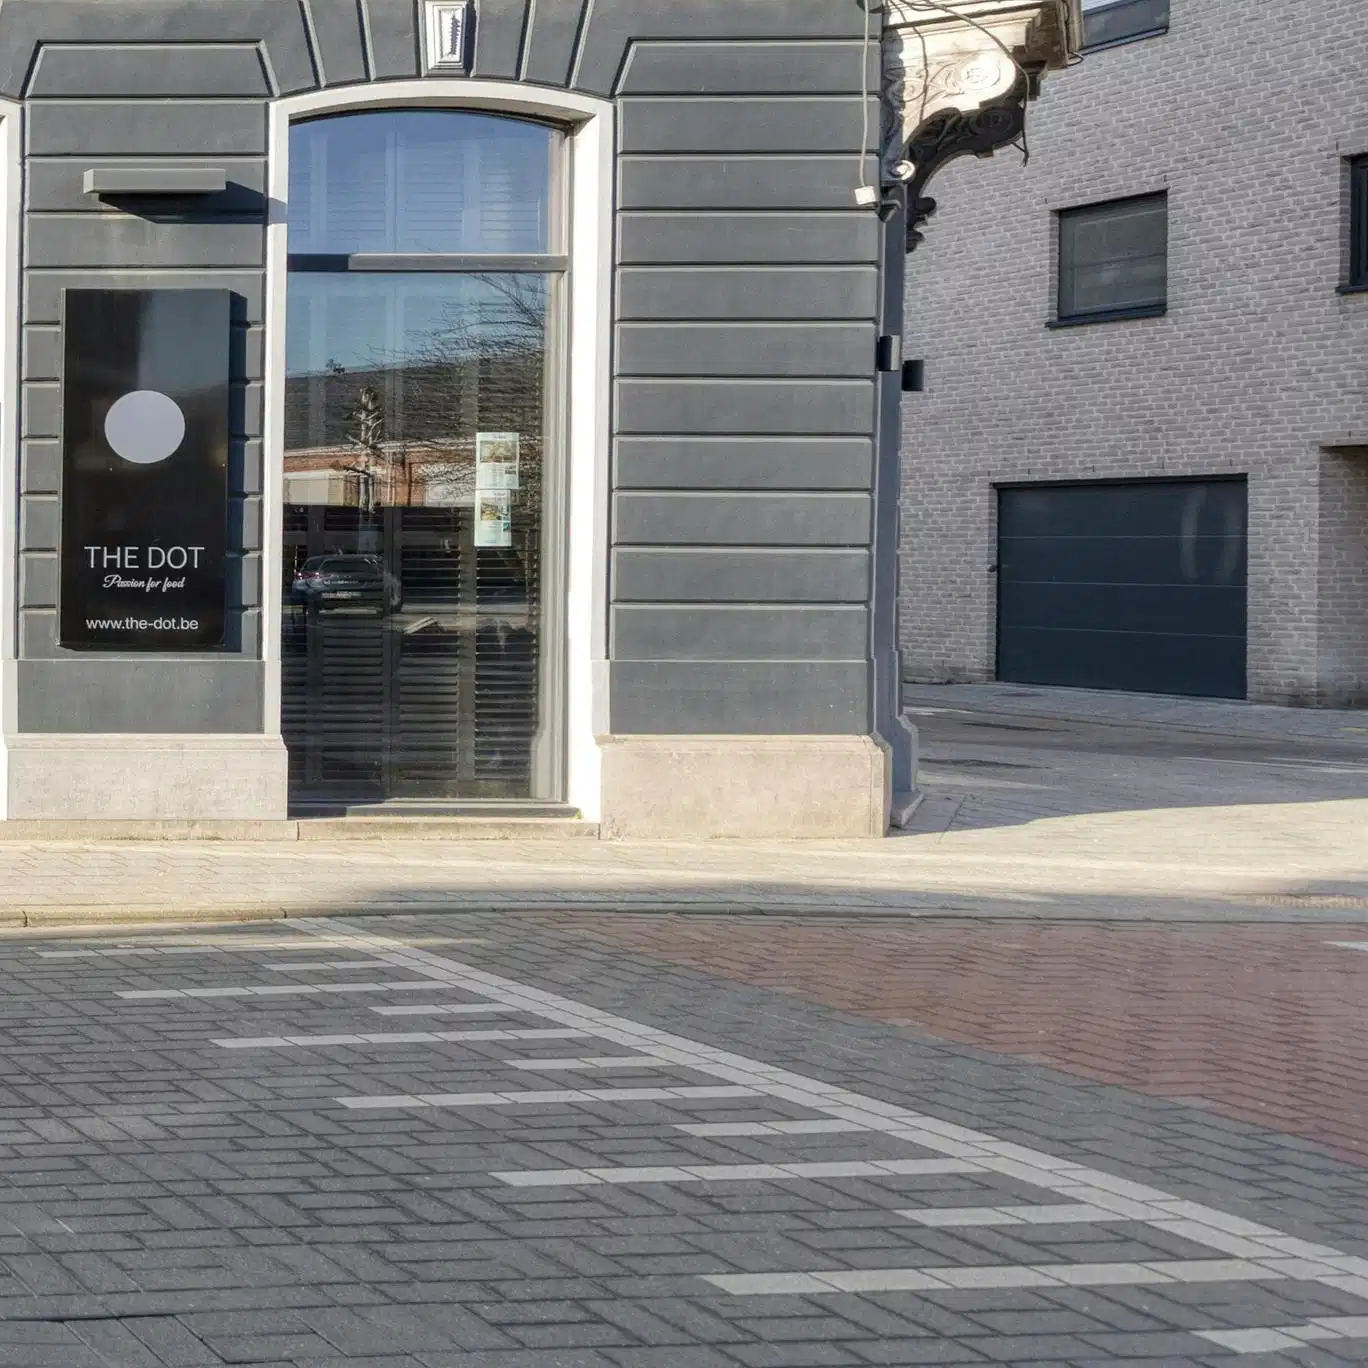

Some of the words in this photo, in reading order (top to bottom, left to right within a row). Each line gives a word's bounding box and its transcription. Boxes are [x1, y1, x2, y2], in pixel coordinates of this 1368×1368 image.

[84, 546, 140, 569] THE
[148, 546, 206, 569] DOT
[102, 574, 145, 588] Passion
[145, 576, 162, 592] for
[162, 576, 186, 592] food
[85, 617, 199, 630] www.the-dot.be
